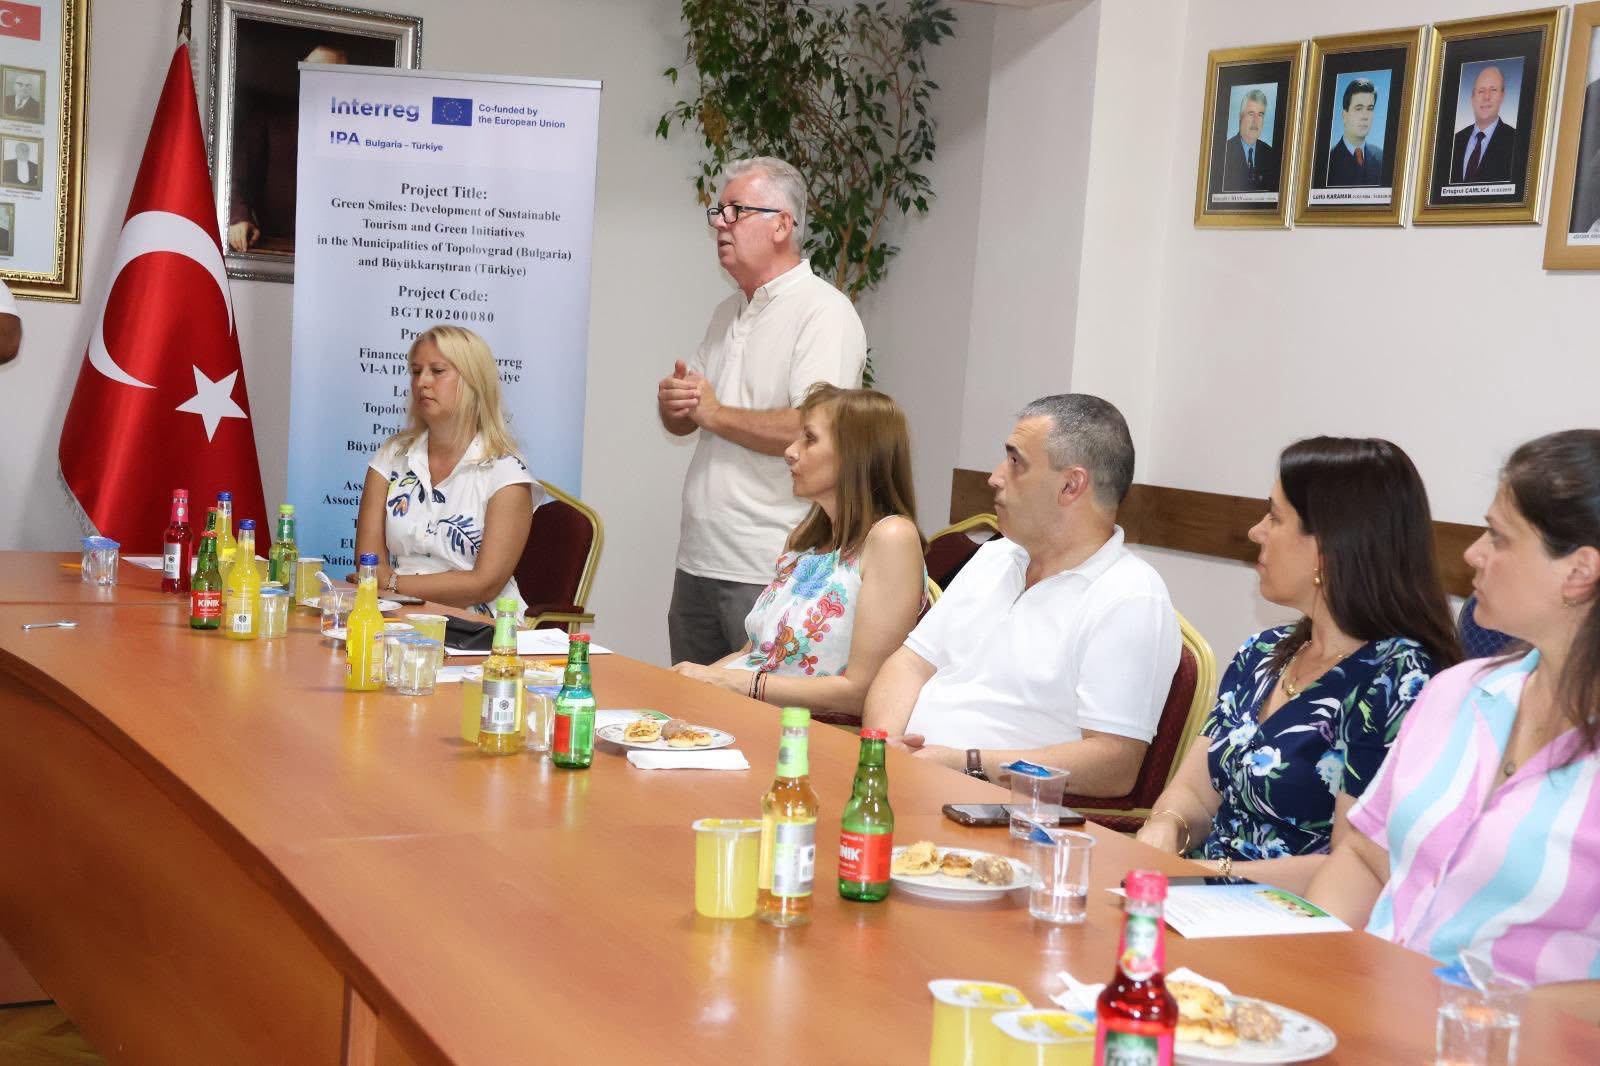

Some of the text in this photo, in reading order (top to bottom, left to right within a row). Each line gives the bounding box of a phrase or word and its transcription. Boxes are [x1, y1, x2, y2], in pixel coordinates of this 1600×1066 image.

[331, 96, 420, 122] Interreg
[478, 104, 538, 117] Co-funded by
[478, 116, 566, 128] the European Union
[330, 131, 360, 145] IPA
[365, 139, 402, 149] Bulgaria
[401, 182, 487, 200] Project Title:
[331, 197, 561, 221] Green Smiles: Development of Sustainable
[362, 219, 525, 238] Tourism and Green Initiatives
[317, 235, 572, 261] in the Municipalities of Topolovgrad (Bulgaria)
[358, 257, 378, 267] and
[474, 263, 527, 277] (Türkiye)
[399, 285, 488, 302] Project Code:
[391, 306, 495, 323] BGTR0200080
[360, 363, 388, 374] VI-A
[392, 365, 408, 375] IP
[362, 402, 408, 416] Topolov
[323, 495, 359, 506] Associ
